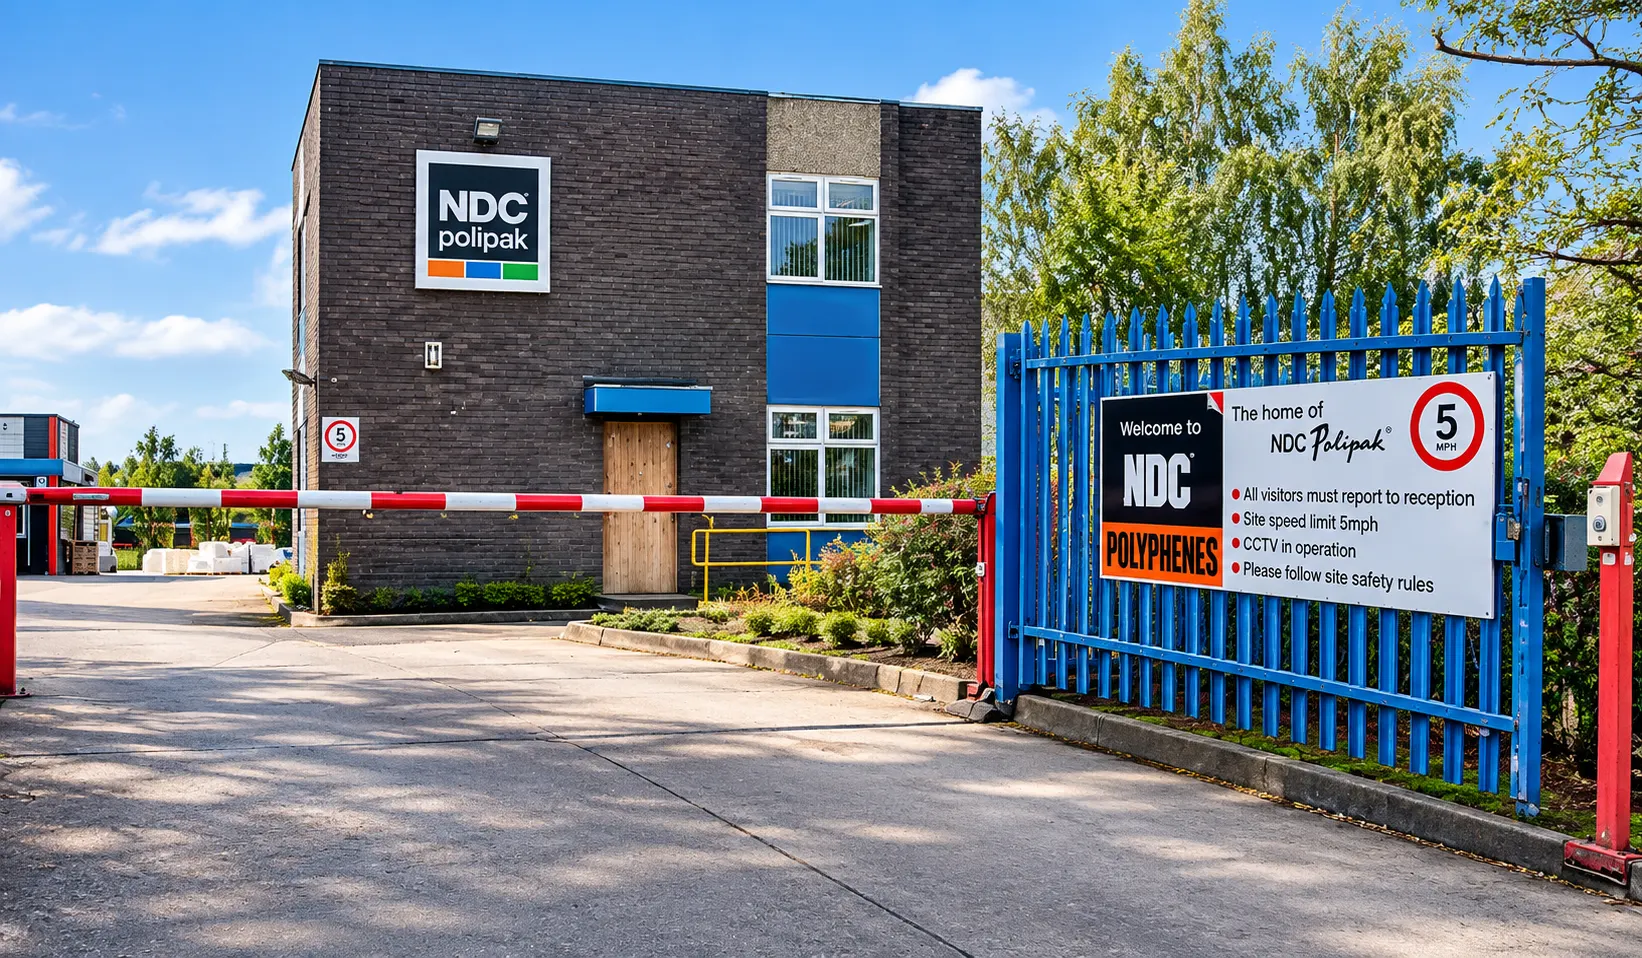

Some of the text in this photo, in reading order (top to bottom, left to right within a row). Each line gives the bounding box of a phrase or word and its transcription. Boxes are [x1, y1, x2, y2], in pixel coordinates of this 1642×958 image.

[438, 226, 529, 254] polipak
[1231, 400, 1324, 422] The home of
[1435, 403, 1458, 441] 5
[336, 427, 346, 442] 5
[1119, 419, 1202, 437] Welcome to
[1270, 432, 1307, 454] NDC
[1435, 442, 1457, 452] MPH
[1243, 486, 1475, 510] All visitors must report to reception
[1243, 510, 1379, 536] Site speed limit 5mph
[1106, 530, 1219, 577] POLYPHENES
[1243, 536, 1357, 559] CCTV in operation
[1243, 561, 1434, 594] Please follow site safety rules
